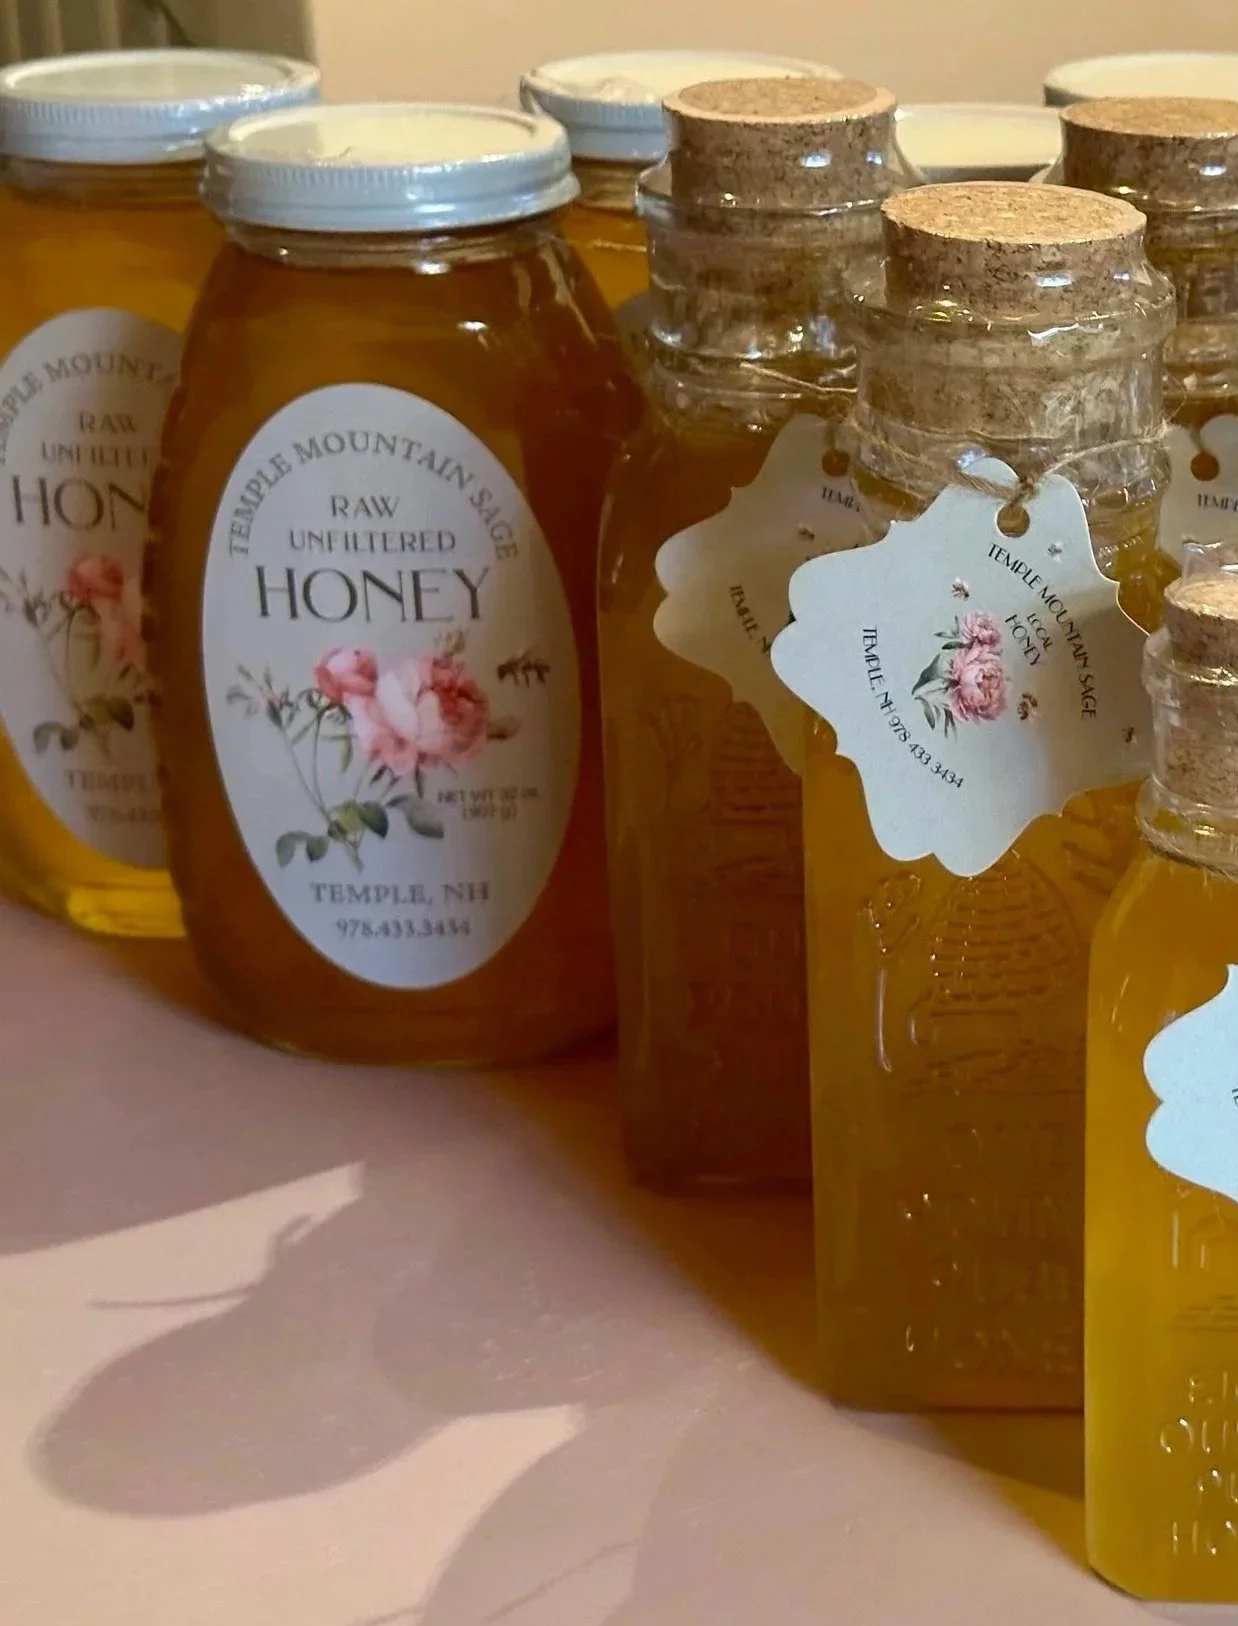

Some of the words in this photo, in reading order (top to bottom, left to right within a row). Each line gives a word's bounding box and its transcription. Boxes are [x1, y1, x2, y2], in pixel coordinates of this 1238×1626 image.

[79, 411, 136, 433] RAW
[12, 474, 147, 531] HON
[229, 453, 292, 559] TEMPLE
[293, 431, 474, 490] MOUNTAIN
[469, 487, 518, 560] SAGE
[331, 495, 399, 519] RAW
[289, 529, 456, 554] UNFILTERED
[256, 565, 490, 623] HONEY
[988, 543, 1042, 590] TEMPLE
[1039, 586, 1089, 669] MOUNTAIN
[1079, 674, 1097, 720] SAGE
[1004, 614, 1041, 666] HONEY
[1026, 613, 1053, 652] LOCAL
[862, 627, 886, 691] TEMPLE,
[876, 690, 897, 716] NH
[888, 716, 911, 743] 978
[908, 742, 932, 765] 433
[931, 762, 964, 788] 3434
[310, 881, 432, 906] TEMPLE,
[442, 880, 490, 903] NH
[335, 917, 471, 940] 978.433.3434
